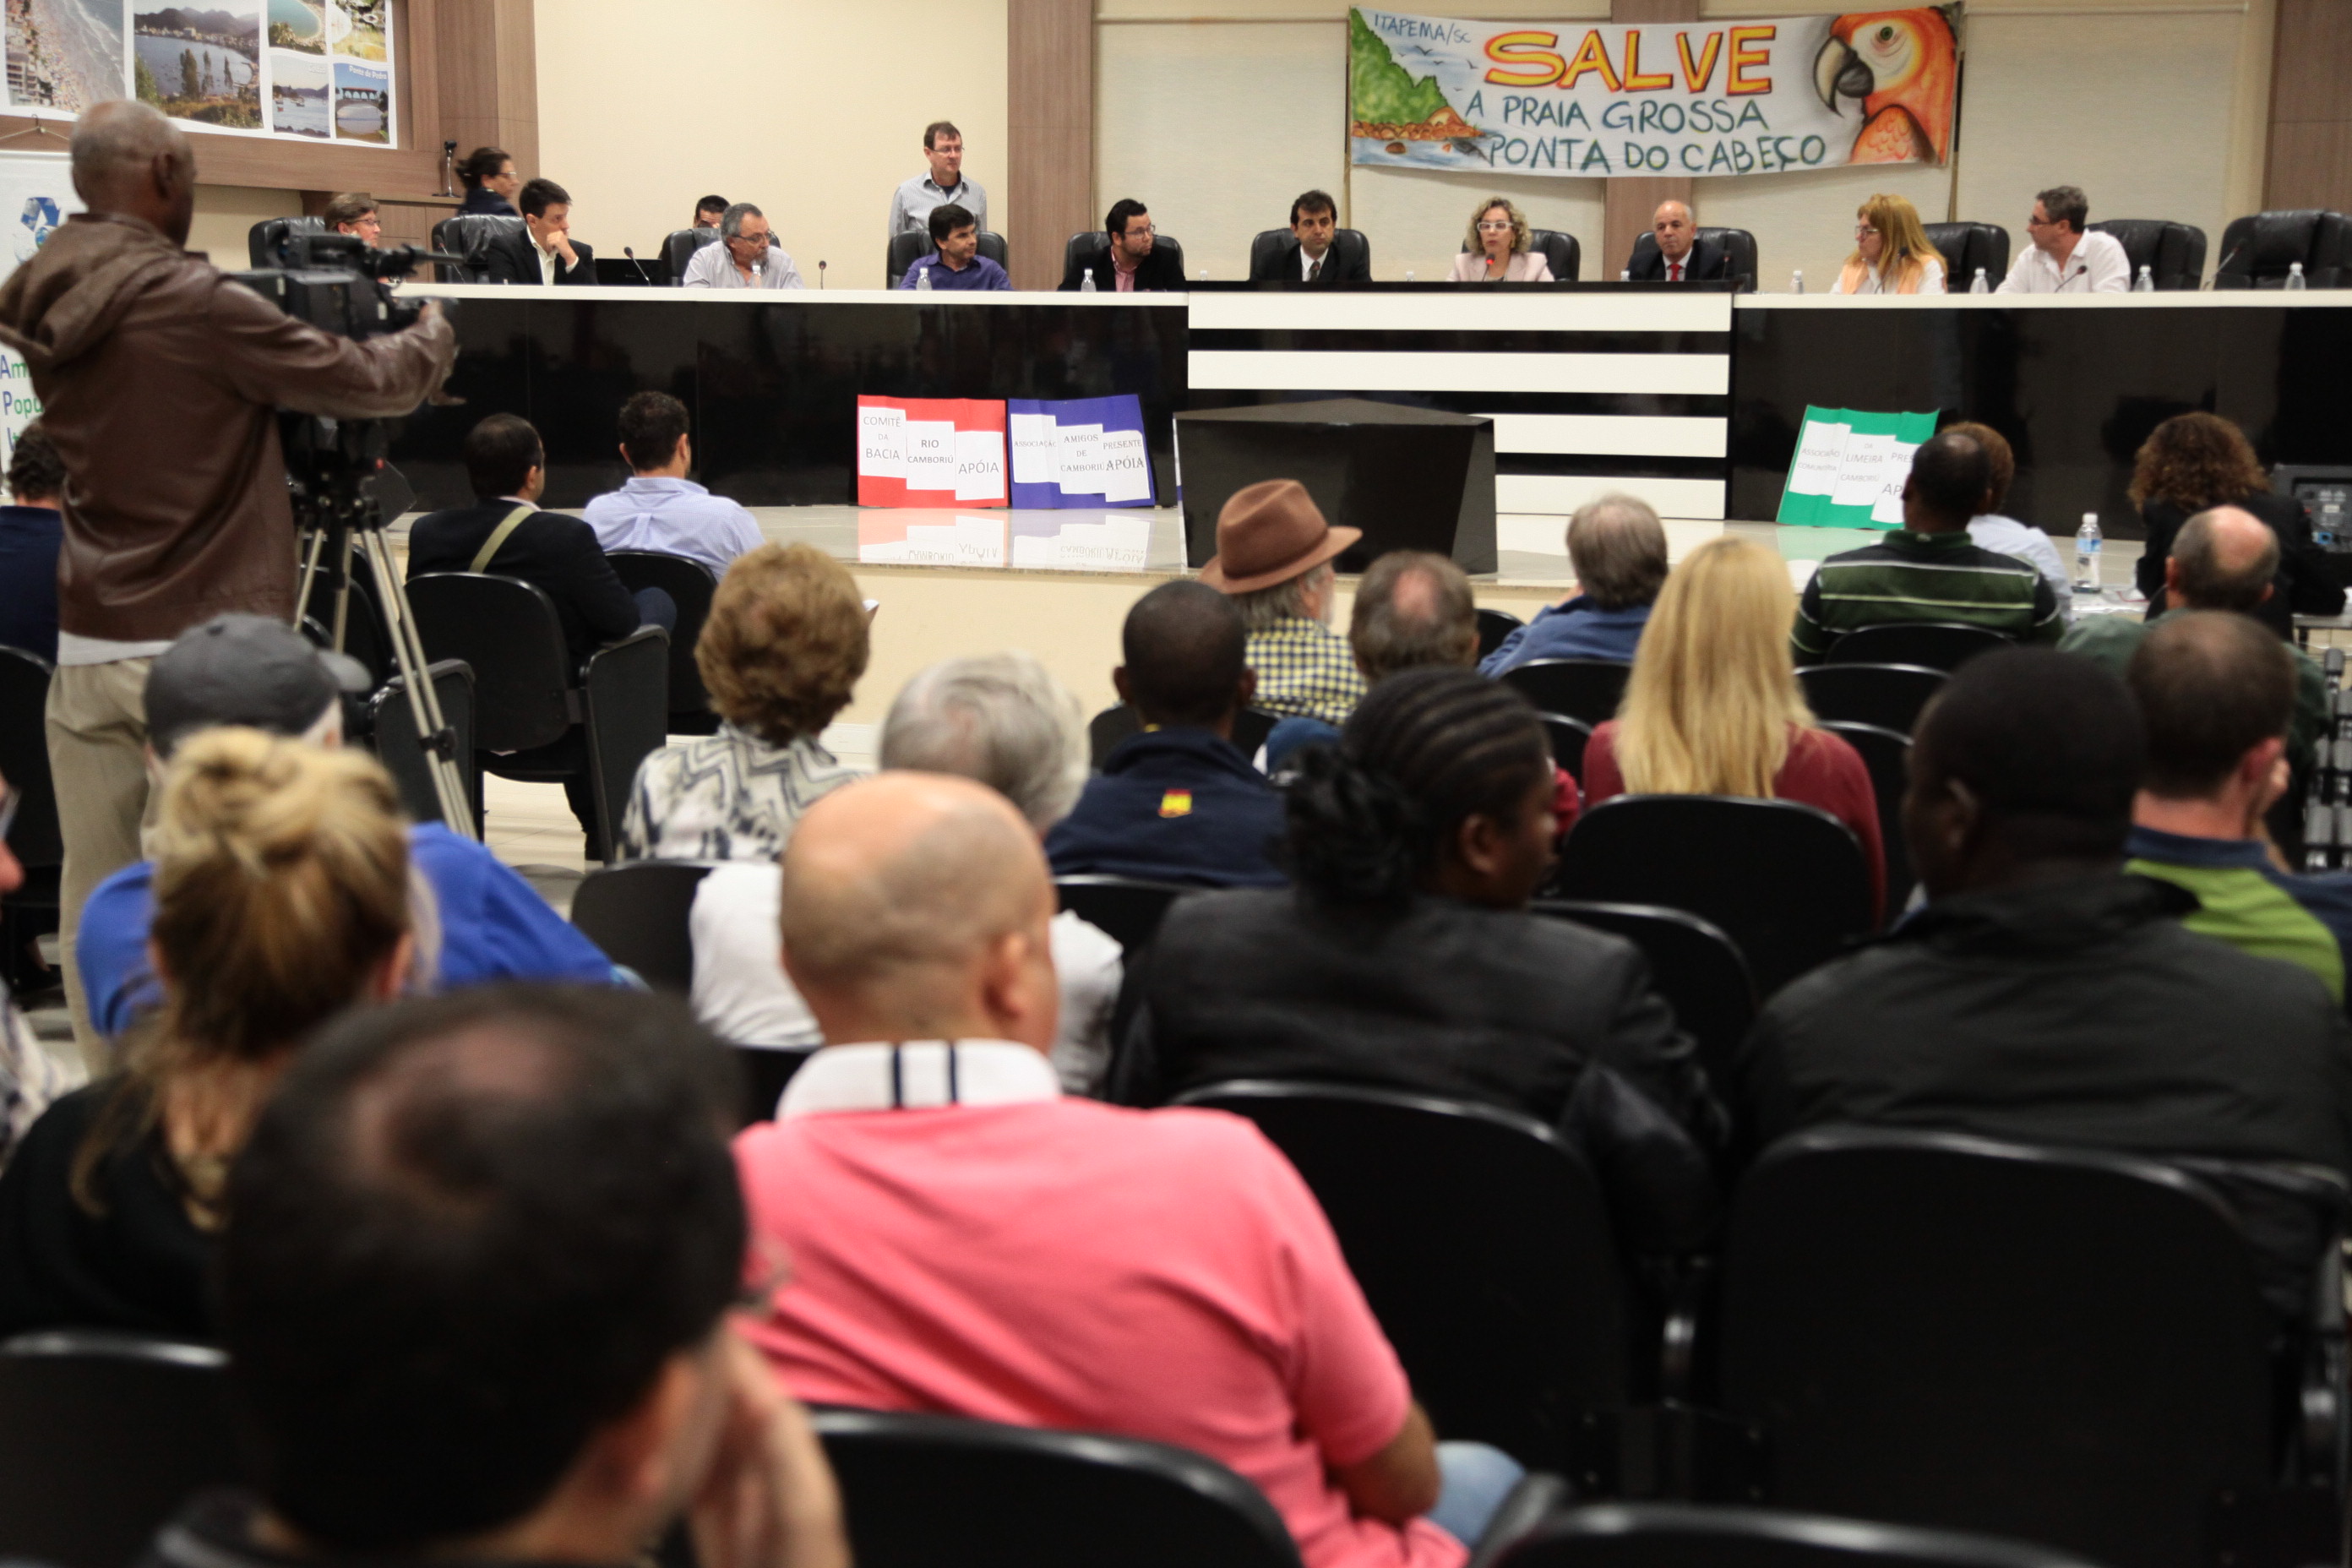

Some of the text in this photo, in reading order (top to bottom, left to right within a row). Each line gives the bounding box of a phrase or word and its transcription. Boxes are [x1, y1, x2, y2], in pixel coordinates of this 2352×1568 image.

[1484, 25, 1776, 96] SALVE
[1466, 90, 1770, 133] A PRAIA GROSSA
[1489, 134, 1826, 175] PONTA DO CABEÇO
[863, 416, 901, 427] COMITÊ
[921, 438, 939, 449] RIO
[1064, 433, 1099, 444] AMIGOS
[1102, 439, 1142, 450] PRESENTE
[865, 448, 900, 460] BACIA
[1846, 453, 1883, 464] LIMEIRA
[907, 455, 954, 465] CAMBORIÚ
[1106, 455, 1145, 471] APÓIA
[958, 459, 999, 475] APÓIA
